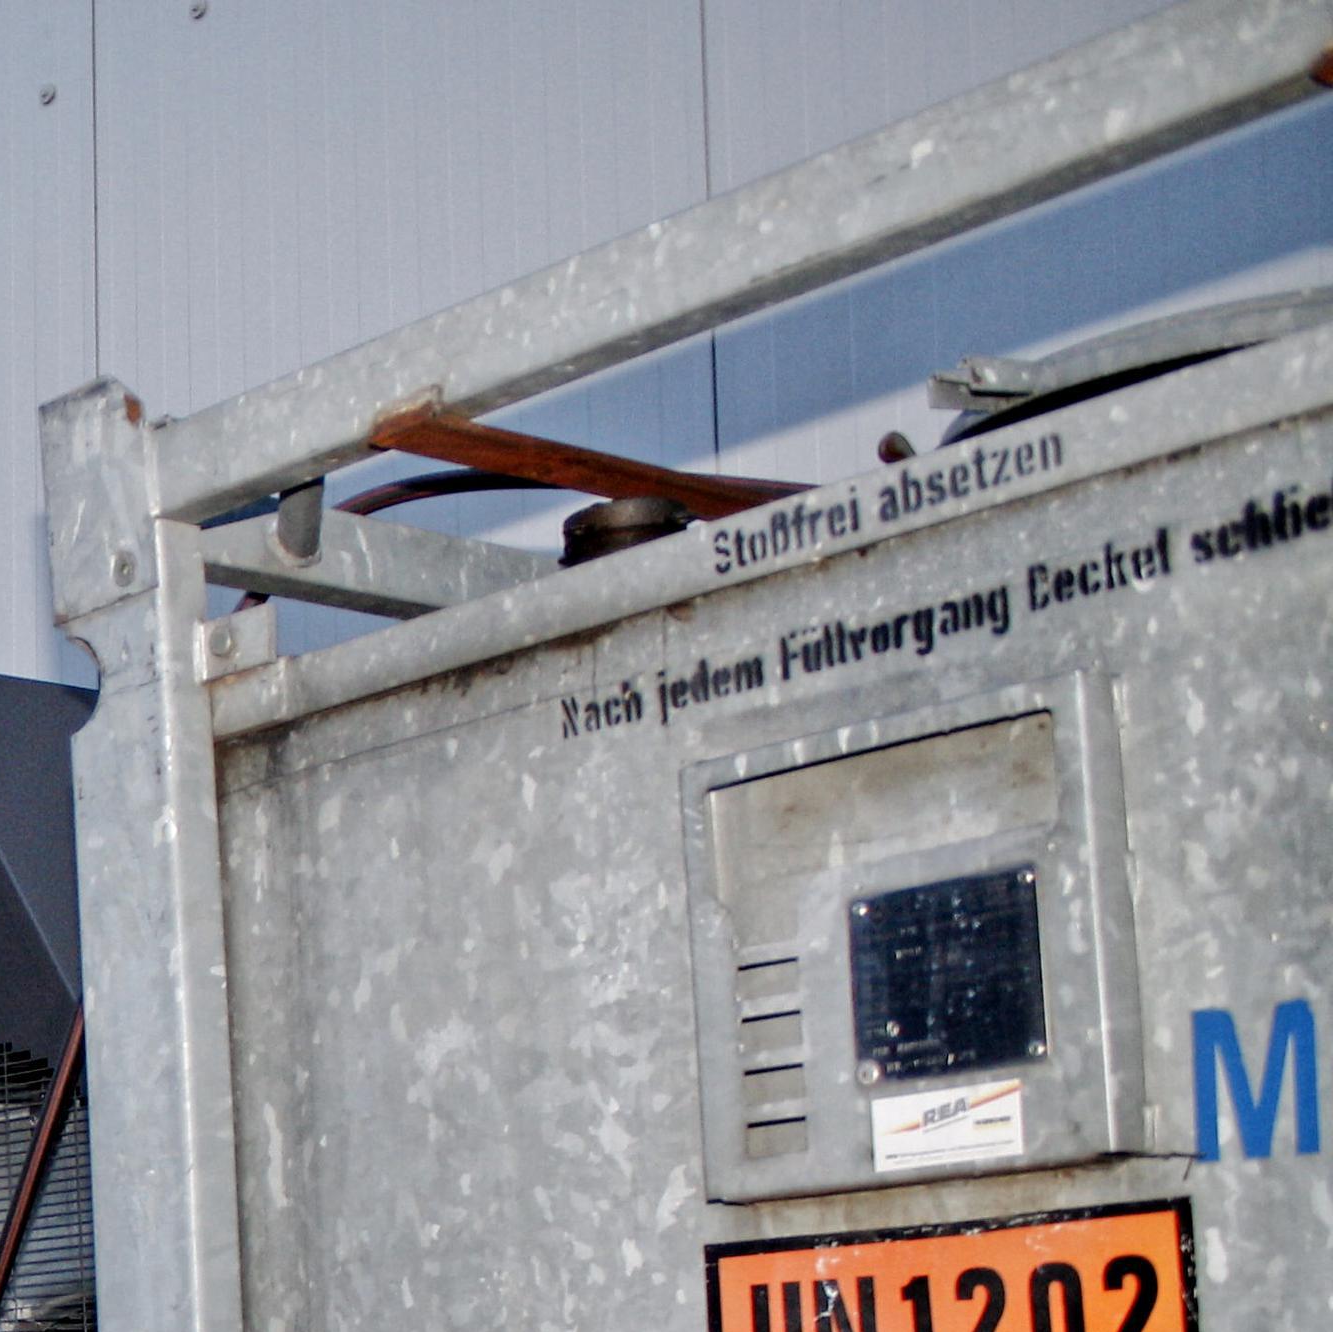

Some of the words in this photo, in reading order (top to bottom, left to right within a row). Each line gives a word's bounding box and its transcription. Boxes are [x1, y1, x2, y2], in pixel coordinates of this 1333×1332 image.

[714, 485, 860, 574] Stoßfrei
[878, 432, 1064, 523] absetzen
[559, 680, 643, 740] Nach
[658, 654, 765, 726] jedem
[779, 583, 1011, 681] Füllvorgang
[1190, 478, 1333, 564] schlie
[1191, 997, 1321, 1164] M
